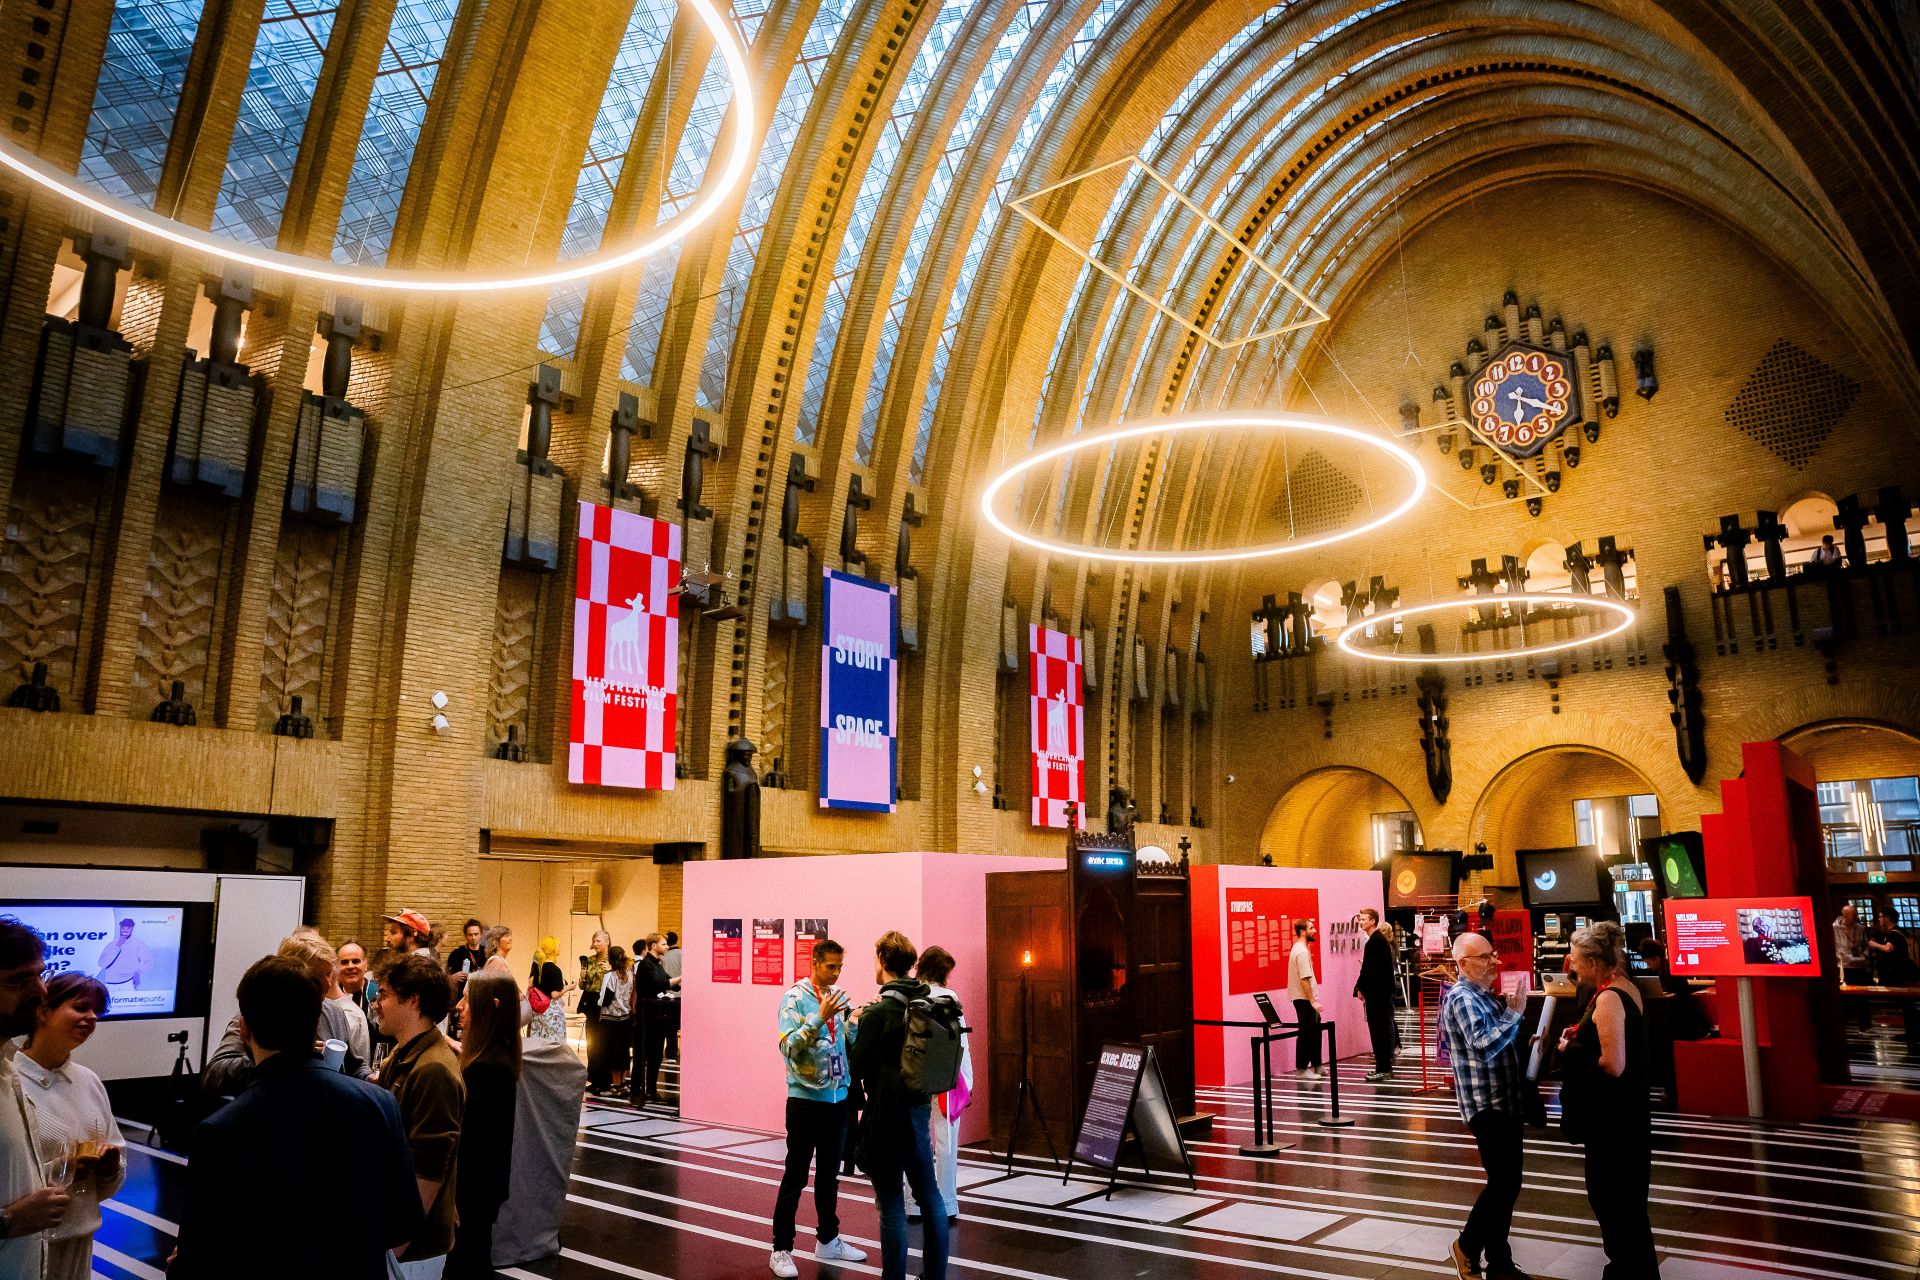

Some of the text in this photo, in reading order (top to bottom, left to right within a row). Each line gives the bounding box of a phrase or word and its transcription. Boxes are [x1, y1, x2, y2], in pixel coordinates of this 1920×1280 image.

[1509, 356, 1523, 371] 12
[1532, 356, 1538, 371] 1
[1491, 365, 1504, 380] 11
[1546, 366, 1555, 381] 2
[1478, 381, 1494, 397] 10
[1552, 382, 1565, 397] 3
[1477, 400, 1489, 414] 9
[1484, 417, 1496, 432] 8
[1537, 417, 1549, 433] 5
[1499, 426, 1510, 441] 7
[1518, 426, 1531, 441] 6
[836, 634, 884, 672] STORY
[583, 676, 667, 698] NEDERLANDS
[582, 689, 667, 712] FILM FESTIVAL
[835, 714, 883, 749] SPACE
[63, 932, 107, 941] over
